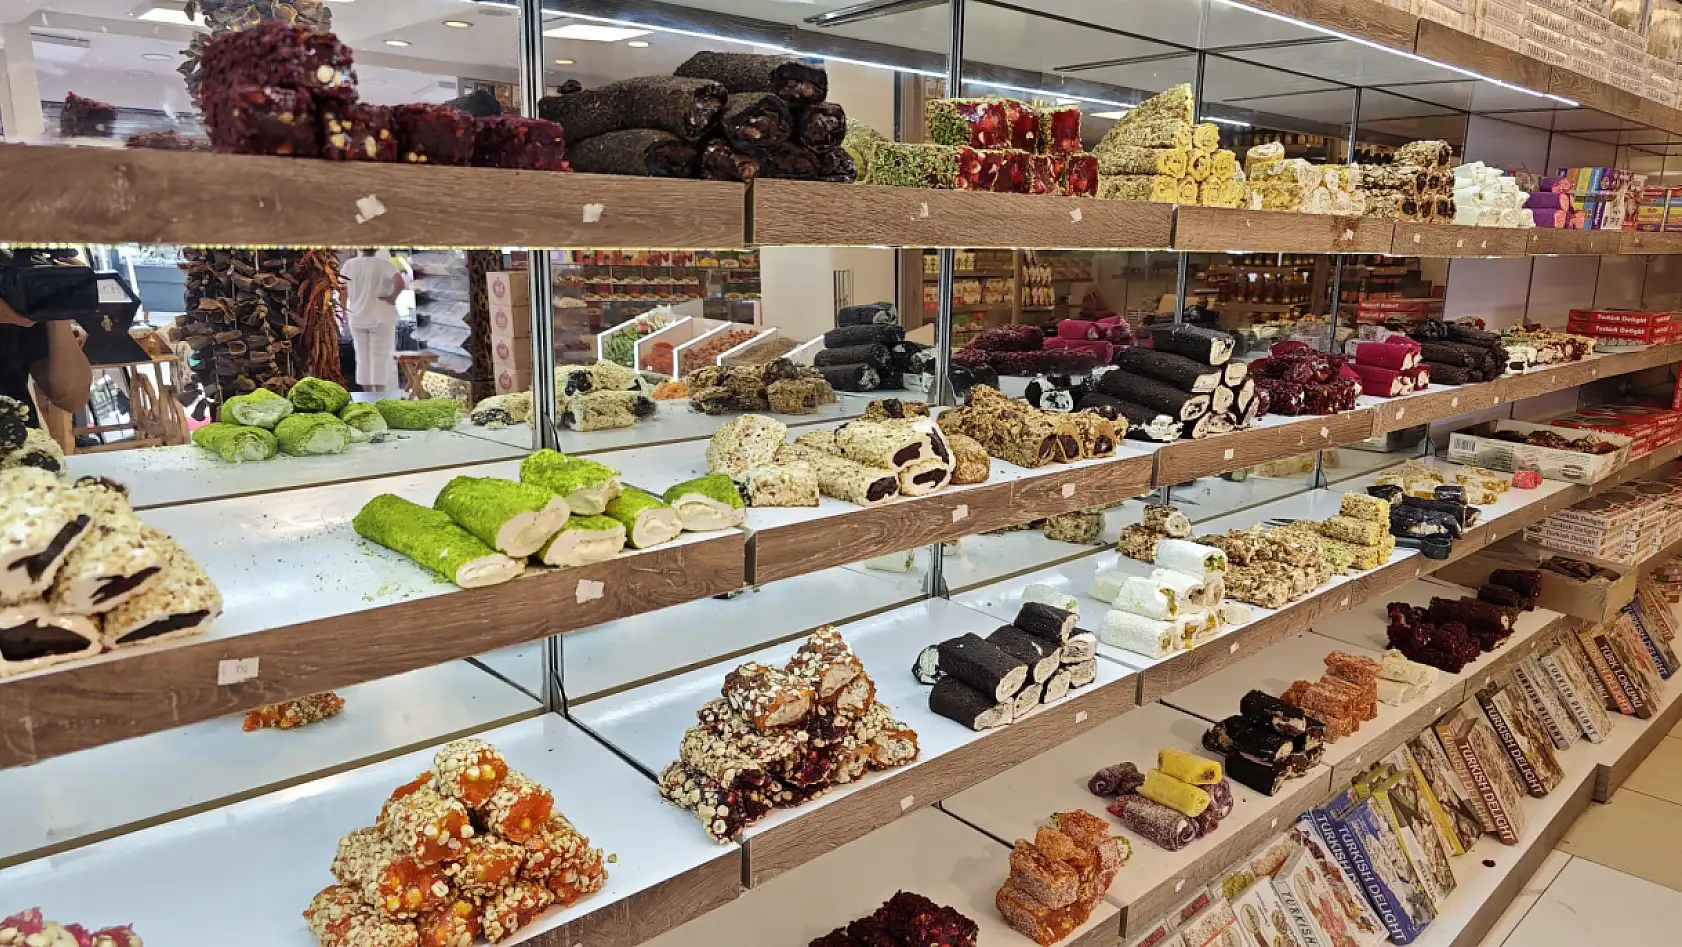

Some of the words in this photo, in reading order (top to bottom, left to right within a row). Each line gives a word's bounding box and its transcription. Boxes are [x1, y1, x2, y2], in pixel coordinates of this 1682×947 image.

[1595, 325, 1618, 333] Turkish
[1620, 327, 1645, 335] Delight
[1622, 315, 1647, 324] Delight
[1440, 730, 1472, 780] TURKISH
[1464, 781, 1492, 829] DELIGHT
[1485, 703, 1516, 749] TURKISH
[1510, 749, 1542, 793] DELIGHT
[1460, 742, 1491, 792] TURKISH
[1484, 792, 1514, 841] DELIGHT
[1318, 813, 1351, 869] TURKISH
[1282, 892, 1317, 945] TURKISH
[1338, 825, 1374, 882] TURKISH
[1369, 884, 1407, 941] DELIGHT
